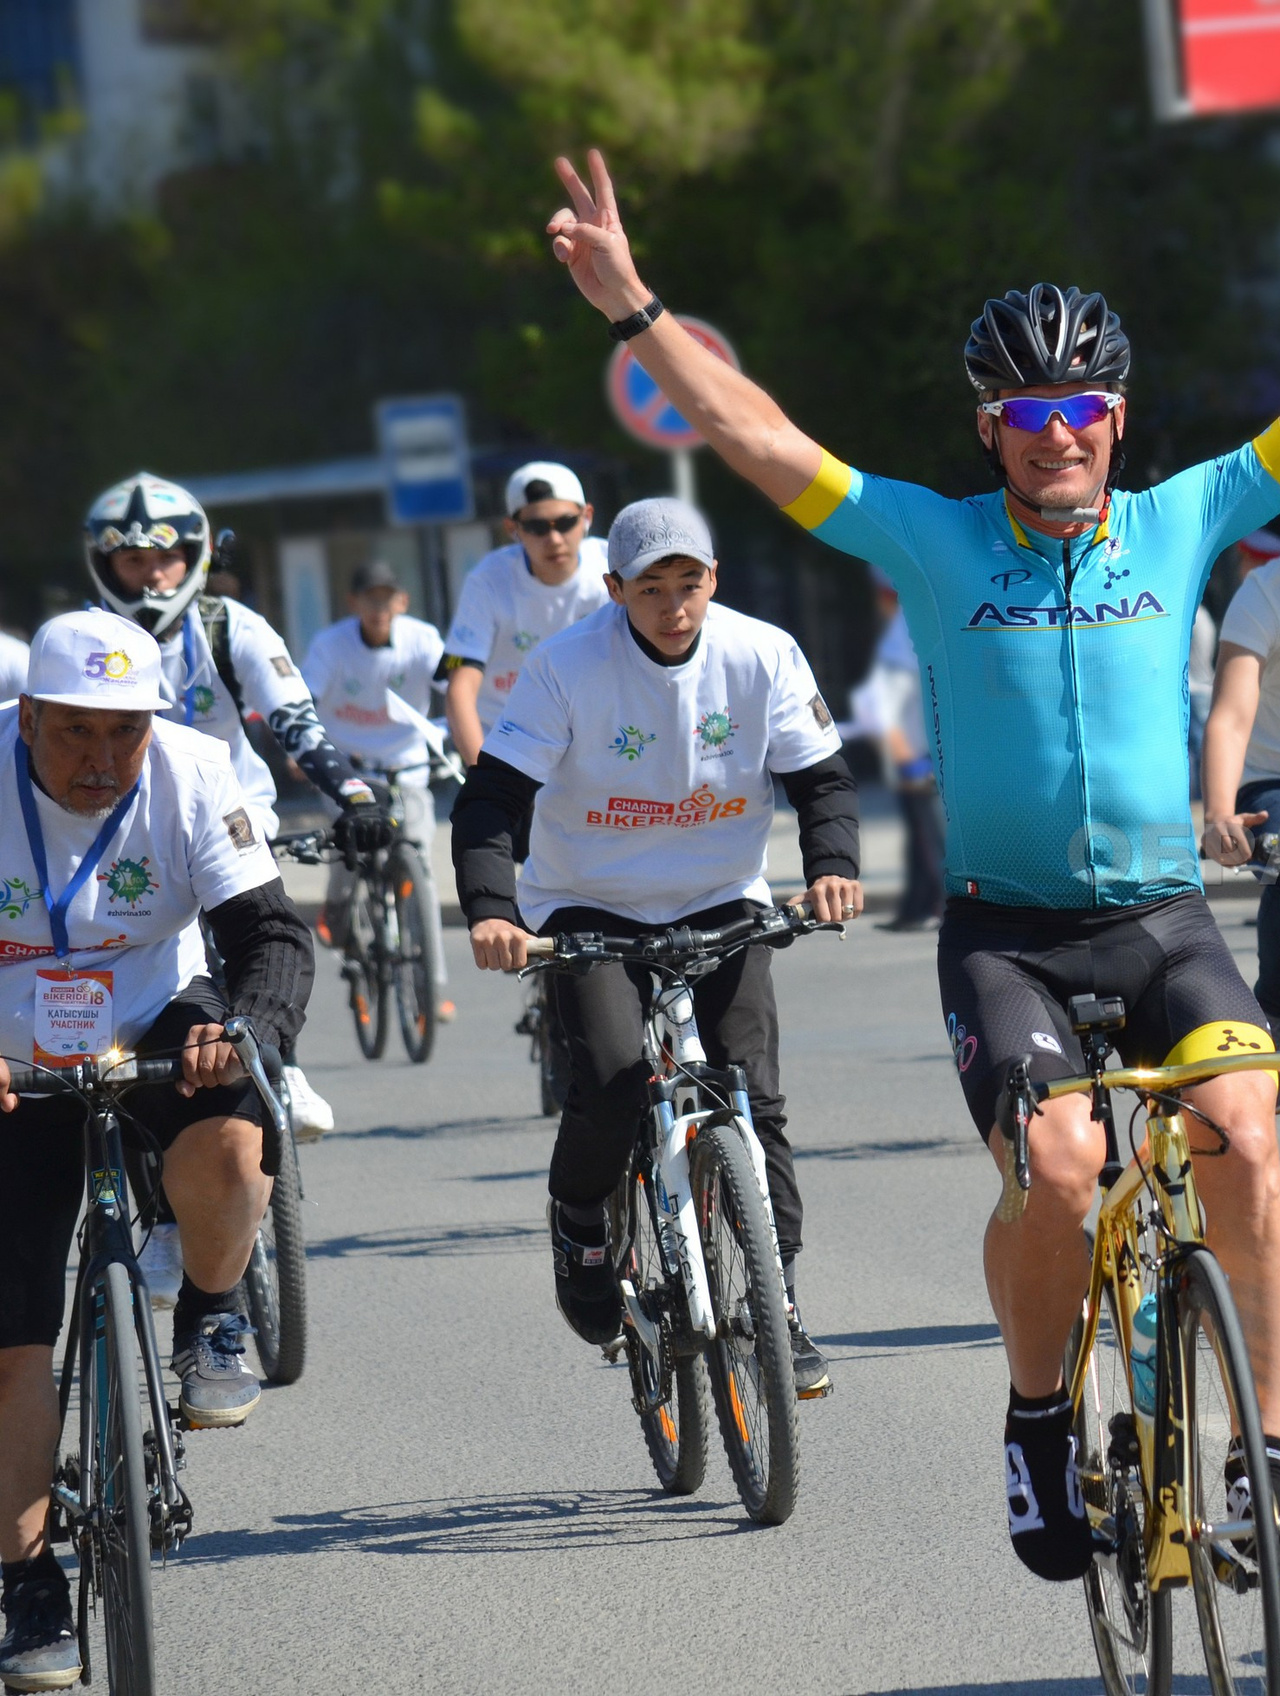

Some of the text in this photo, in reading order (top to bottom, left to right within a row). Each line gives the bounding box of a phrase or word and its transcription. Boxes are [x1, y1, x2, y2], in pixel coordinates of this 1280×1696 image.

[968, 591, 1165, 626] ASTANA
[84, 652, 128, 678] 50
[586, 797, 747, 827] BIKERIDE 18
[613, 800, 669, 814] CHARITY
[4, 944, 55, 955] CHAR
[90, 991, 104, 1005] 18
[47, 1009, 99, 1019] ҚАТЫСУШЫ
[50, 1021, 95, 1029] УЧАСТНИК
